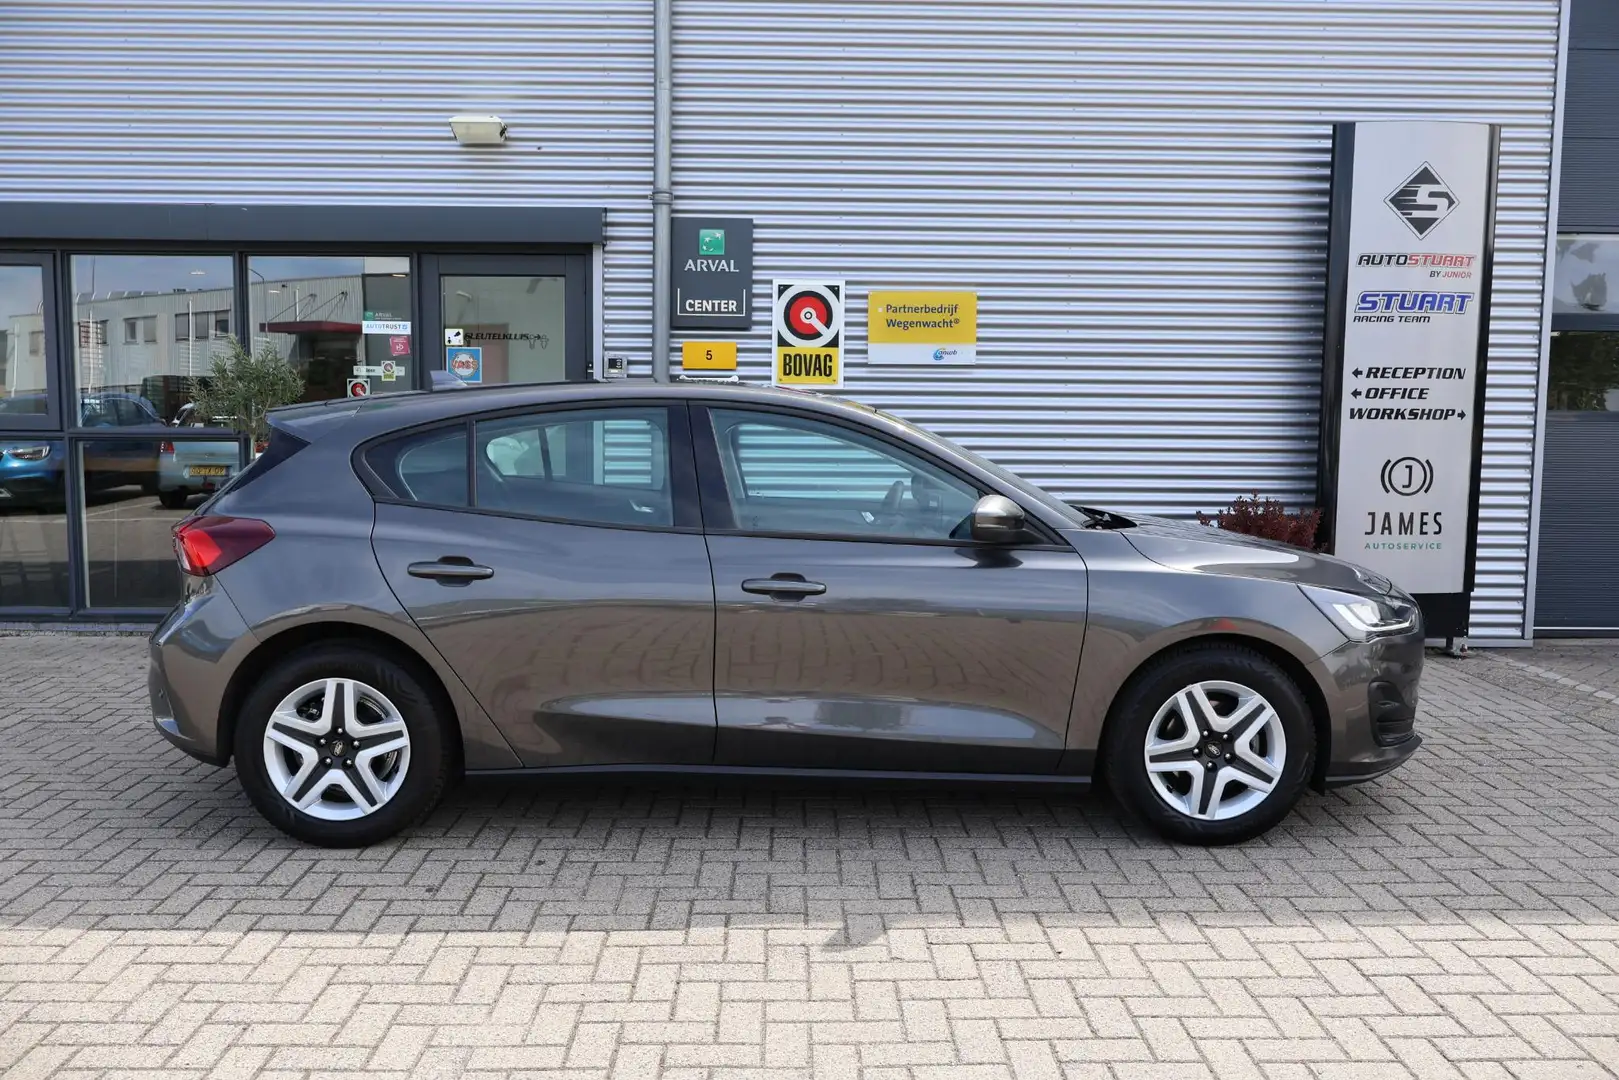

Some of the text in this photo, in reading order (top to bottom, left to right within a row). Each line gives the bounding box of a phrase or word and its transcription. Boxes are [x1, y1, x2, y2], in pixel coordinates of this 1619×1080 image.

[684, 259, 740, 273] ARVAL
[1356, 253, 1476, 268] AUTOSTUART
[1429, 270, 1472, 279] BY JUNIOR
[685, 299, 738, 313] CENTER
[1354, 290, 1475, 315] STUART
[885, 303, 959, 317] Partnerbedrijf
[1353, 315, 1431, 323] RACING TEAM
[705, 349, 713, 361] 5
[782, 353, 833, 378] BOVAG
[1365, 366, 1467, 380] RECEPTION
[1364, 387, 1430, 400] OFFICE
[1349, 408, 1456, 421] WORKSHOP
[1364, 511, 1443, 536] JAMES
[1364, 542, 1443, 550] AUTOSERVICE
